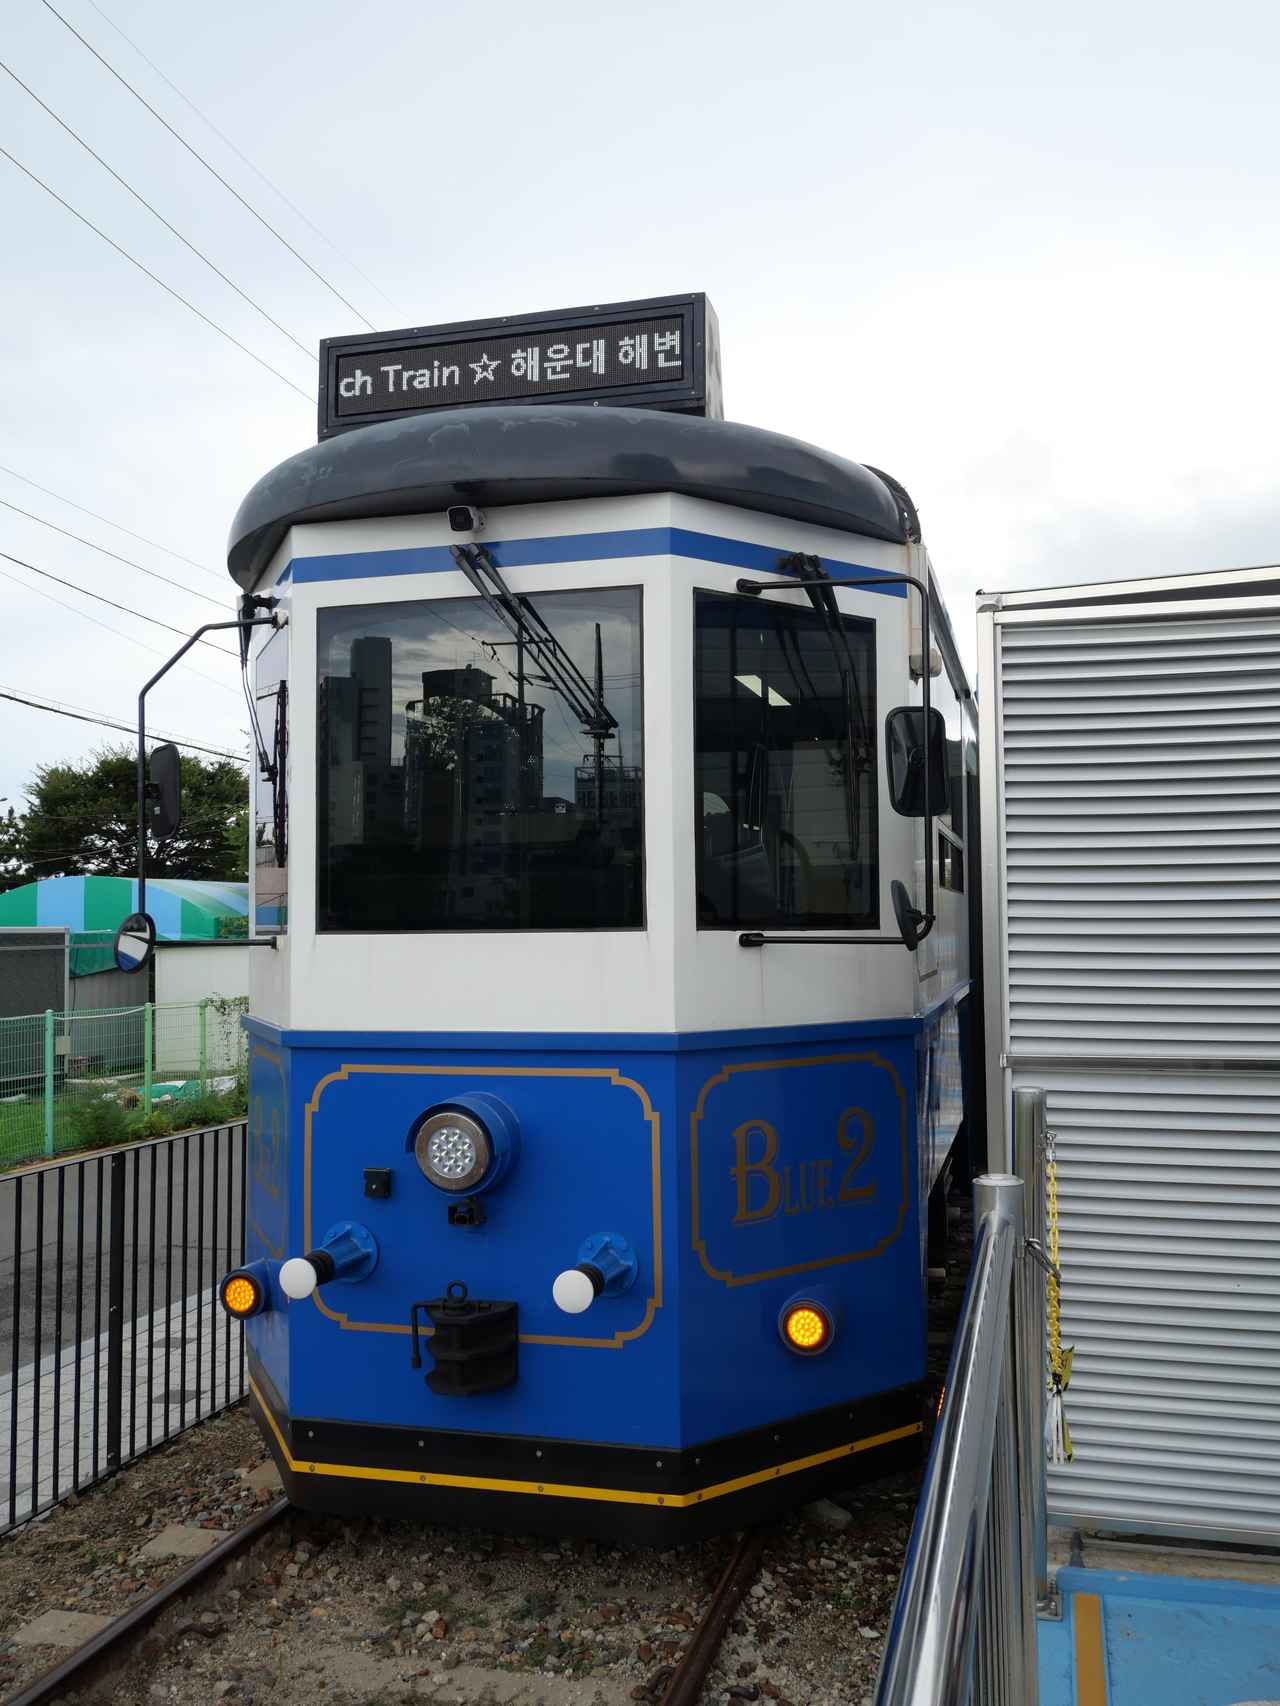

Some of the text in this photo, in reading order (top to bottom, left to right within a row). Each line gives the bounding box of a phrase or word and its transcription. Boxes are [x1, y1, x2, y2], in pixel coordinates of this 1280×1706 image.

[339, 330, 682, 397] ch Train 해운대 해변
